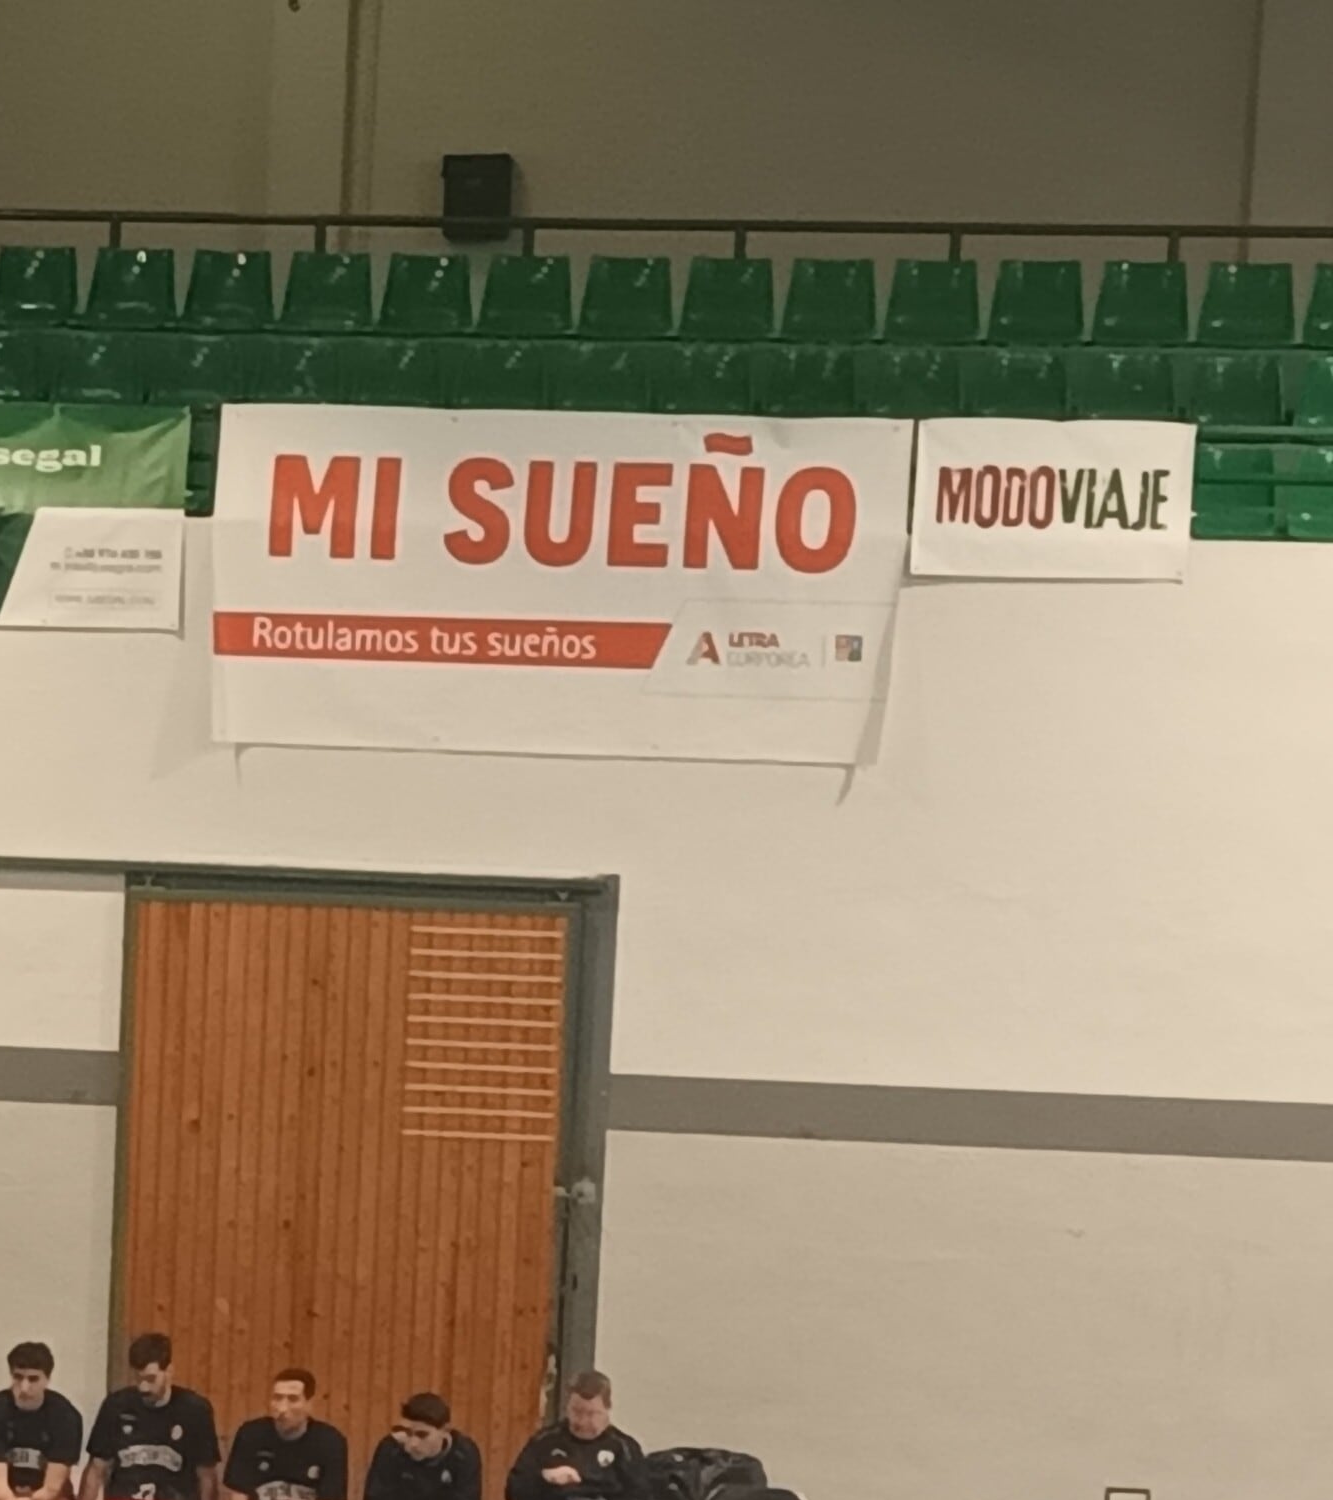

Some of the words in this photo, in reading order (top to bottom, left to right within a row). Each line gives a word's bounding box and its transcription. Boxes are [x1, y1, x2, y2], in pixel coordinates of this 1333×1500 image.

[268, 454, 402, 560] MI
[443, 433, 857, 574] SUEÑO
[935, 464, 1171, 531] MODOVIAJE
[252, 616, 419, 653] Rotulamos
[430, 627, 478, 655] tus
[487, 627, 597, 660] sueños
